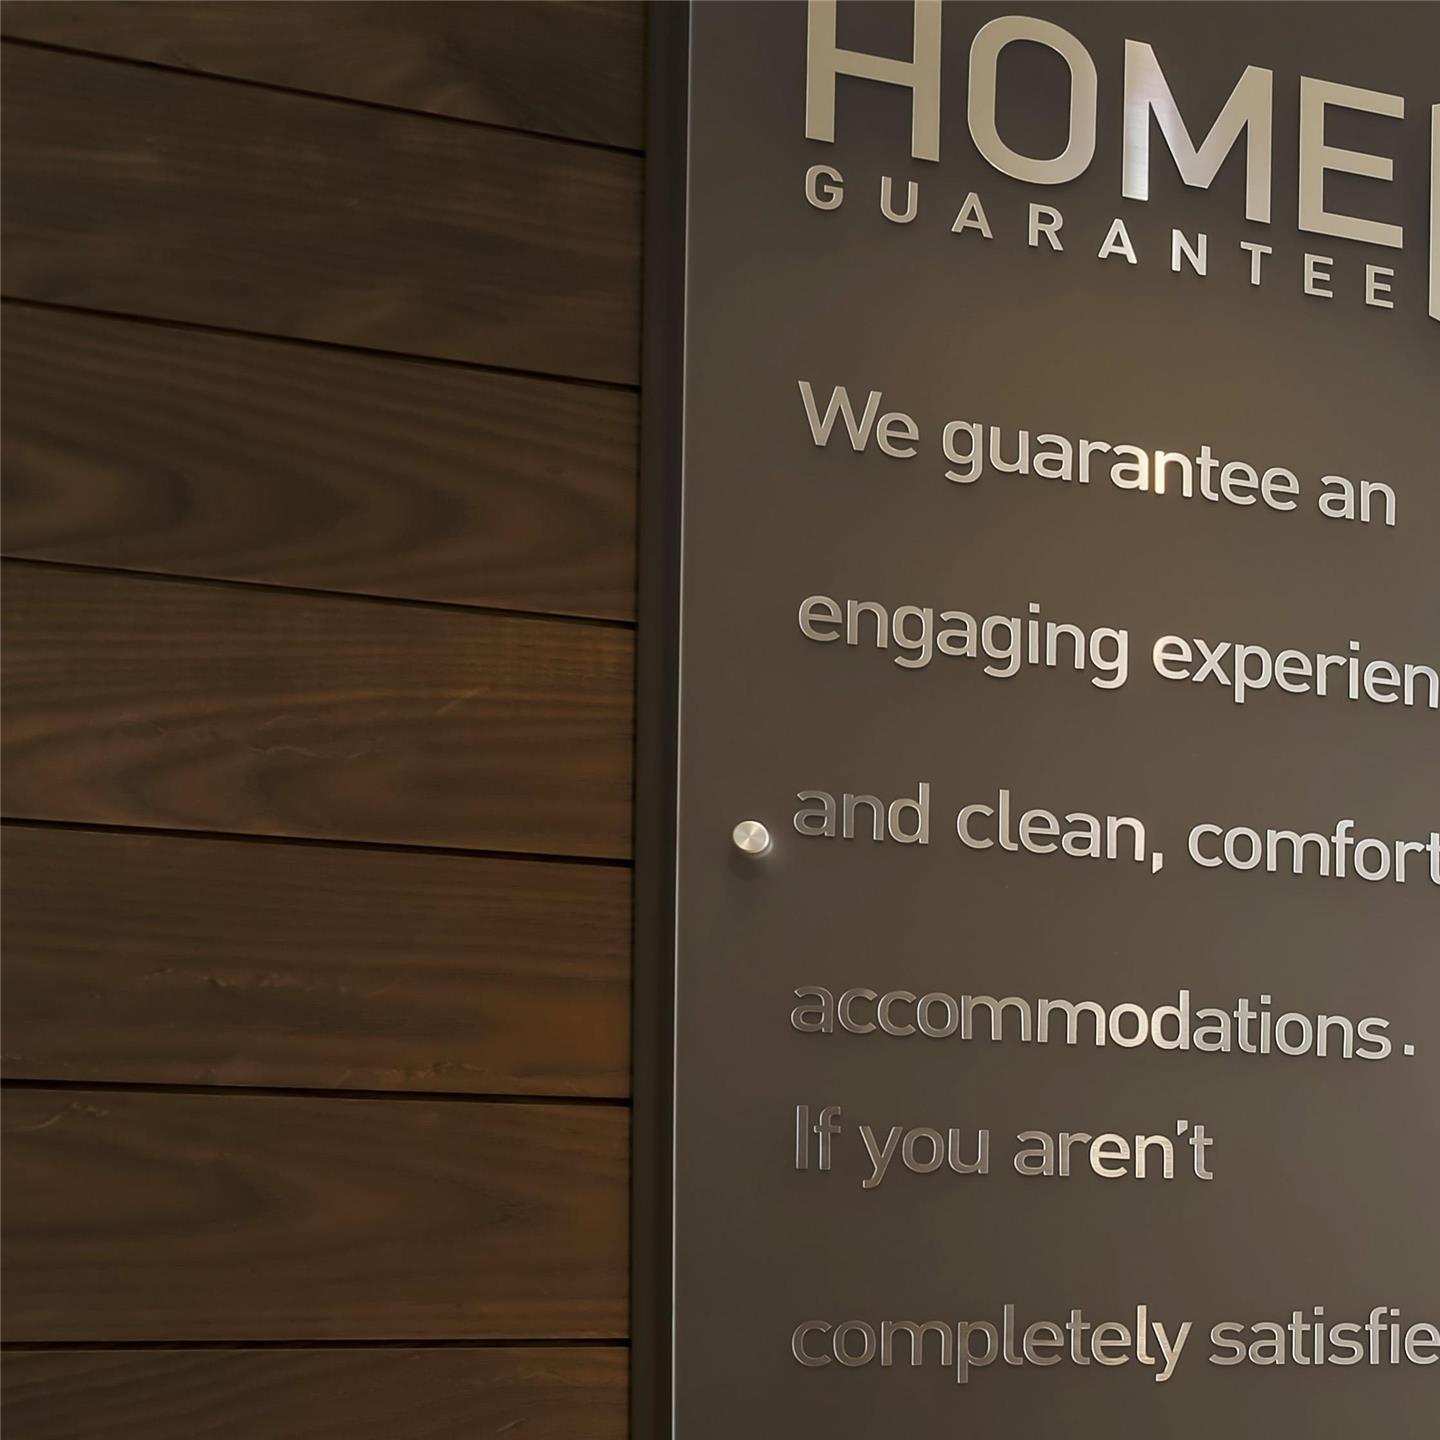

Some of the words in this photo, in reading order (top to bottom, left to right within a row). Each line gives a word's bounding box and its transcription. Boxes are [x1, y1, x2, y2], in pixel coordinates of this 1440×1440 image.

[805, 0, 1405, 248] HOME
[805, 165, 1395, 309] GUARANTEE
[798, 380, 920, 458] We
[942, 419, 1301, 511] guarantee
[1318, 473, 1397, 526] an
[798, 595, 1129, 689] engaging
[793, 782, 930, 845] and
[957, 789, 1164, 873] clean,
[790, 985, 1416, 1060] accommodations.
[795, 1105, 842, 1171] If
[859, 1125, 990, 1189] you
[1013, 1120, 1214, 1181] aren't
[791, 1303, 1193, 1384] completely
